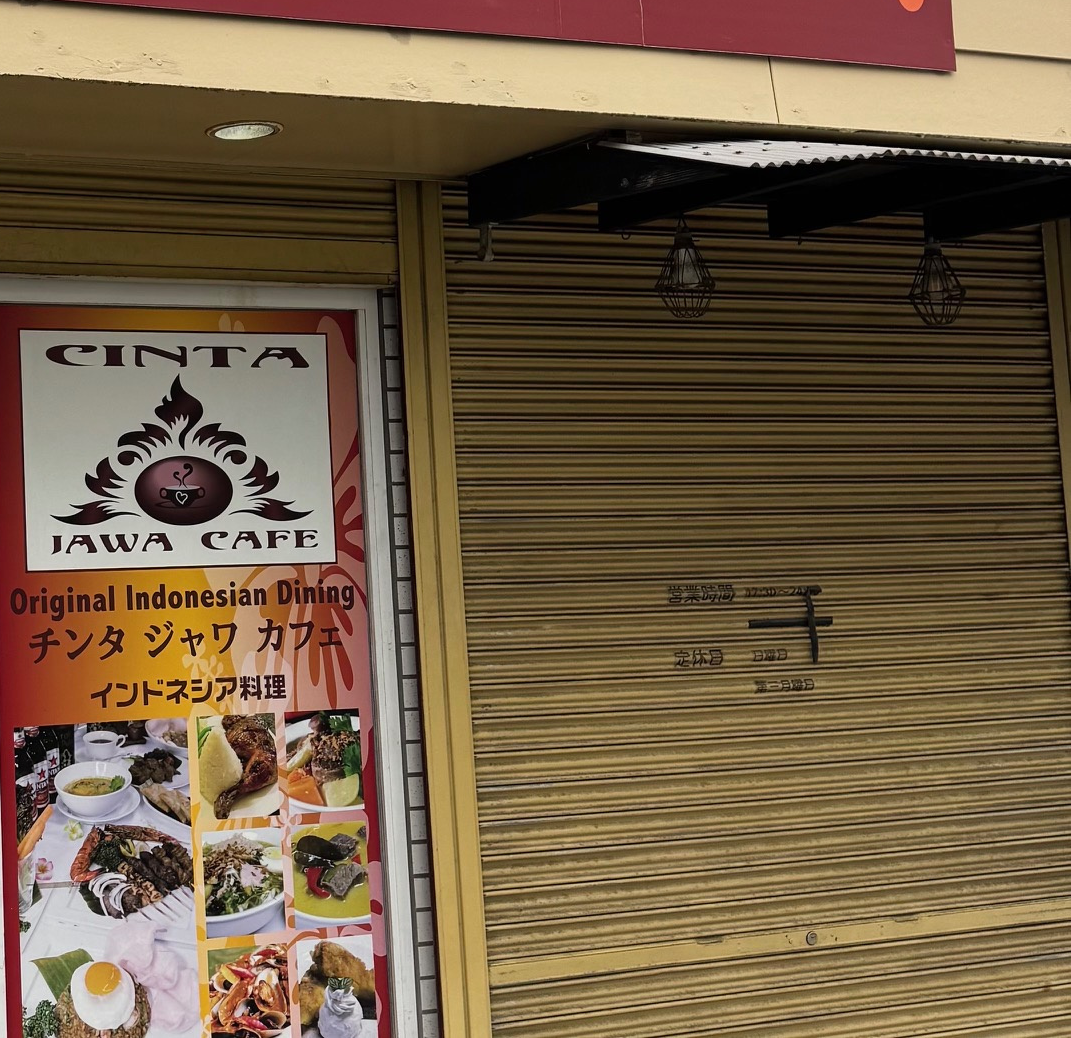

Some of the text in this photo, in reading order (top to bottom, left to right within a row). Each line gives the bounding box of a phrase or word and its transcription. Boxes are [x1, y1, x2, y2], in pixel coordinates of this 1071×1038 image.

[45, 344, 310, 369] CINTA
[51, 530, 319, 555] JAWA CAFE
[10, 578, 355, 621] Original Indonesian Dining
[29, 618, 343, 664] チンタ ジャワ カフェ
[90, 674, 287, 708] インドネシア料理
